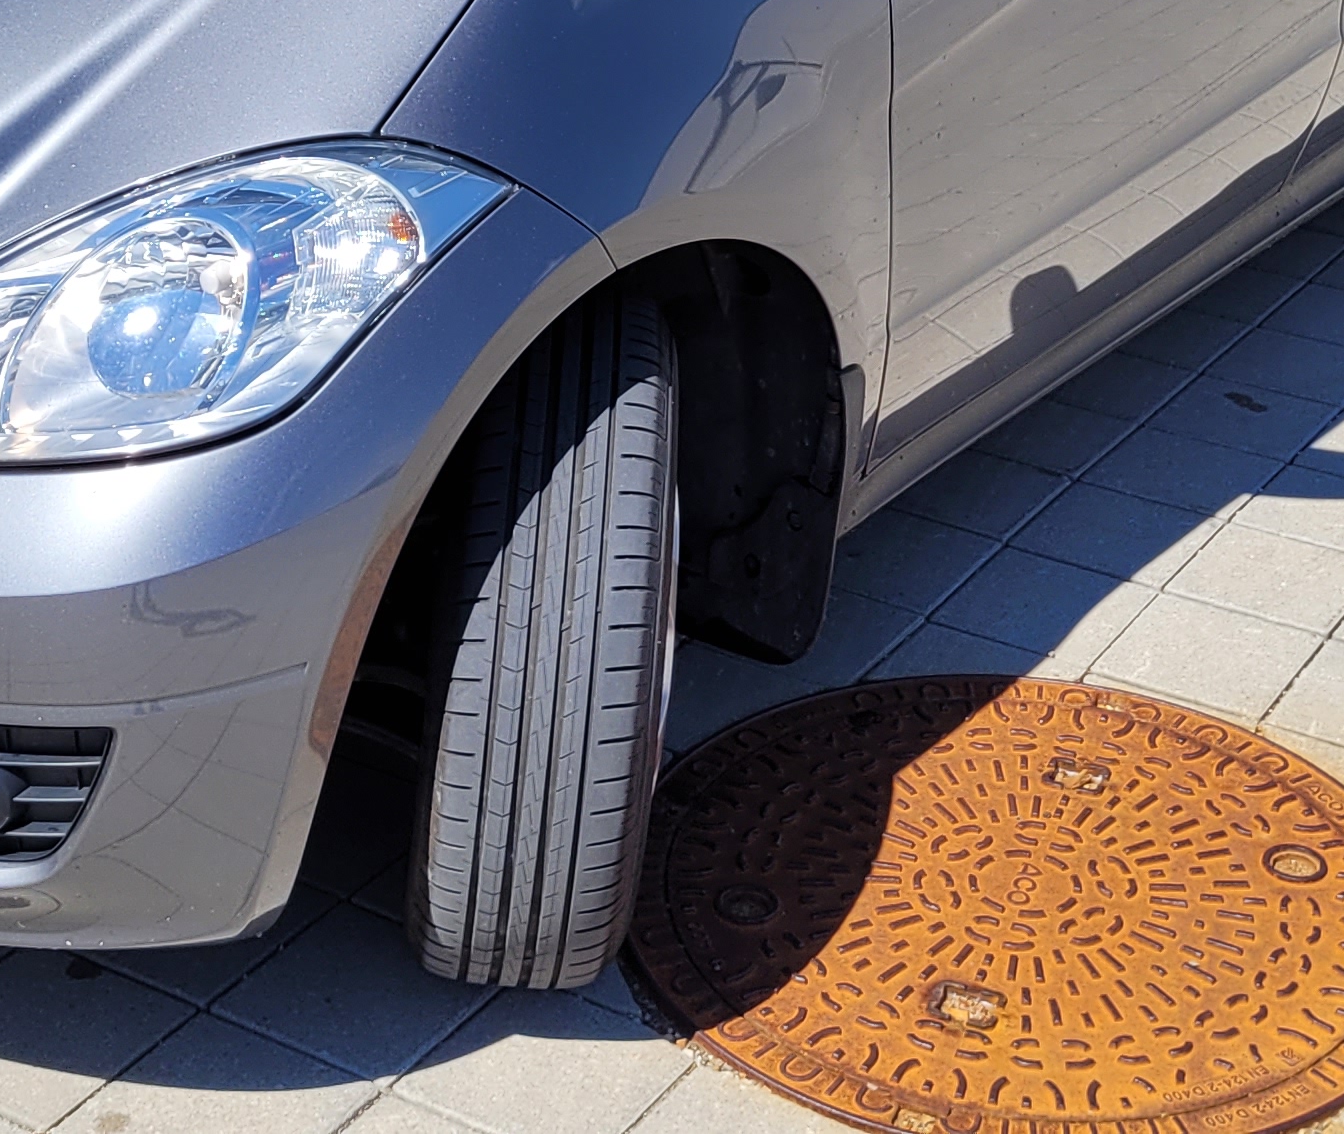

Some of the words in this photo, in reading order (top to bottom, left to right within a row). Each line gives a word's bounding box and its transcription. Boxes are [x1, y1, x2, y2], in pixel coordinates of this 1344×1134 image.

[1307, 784, 1344, 811] ACO
[1006, 861, 1043, 906] ACO
[1250, 1065, 1270, 1079] EN
[1192, 1085, 1206, 1097] D
[1209, 1075, 1248, 1093] 124-2
[1288, 1083, 1311, 1099] EN
[1163, 1089, 1191, 1103] 400
[1252, 1095, 1287, 1114] 124-2
[1205, 1112, 1234, 1127] 400
[1235, 1108, 1249, 1119] D
